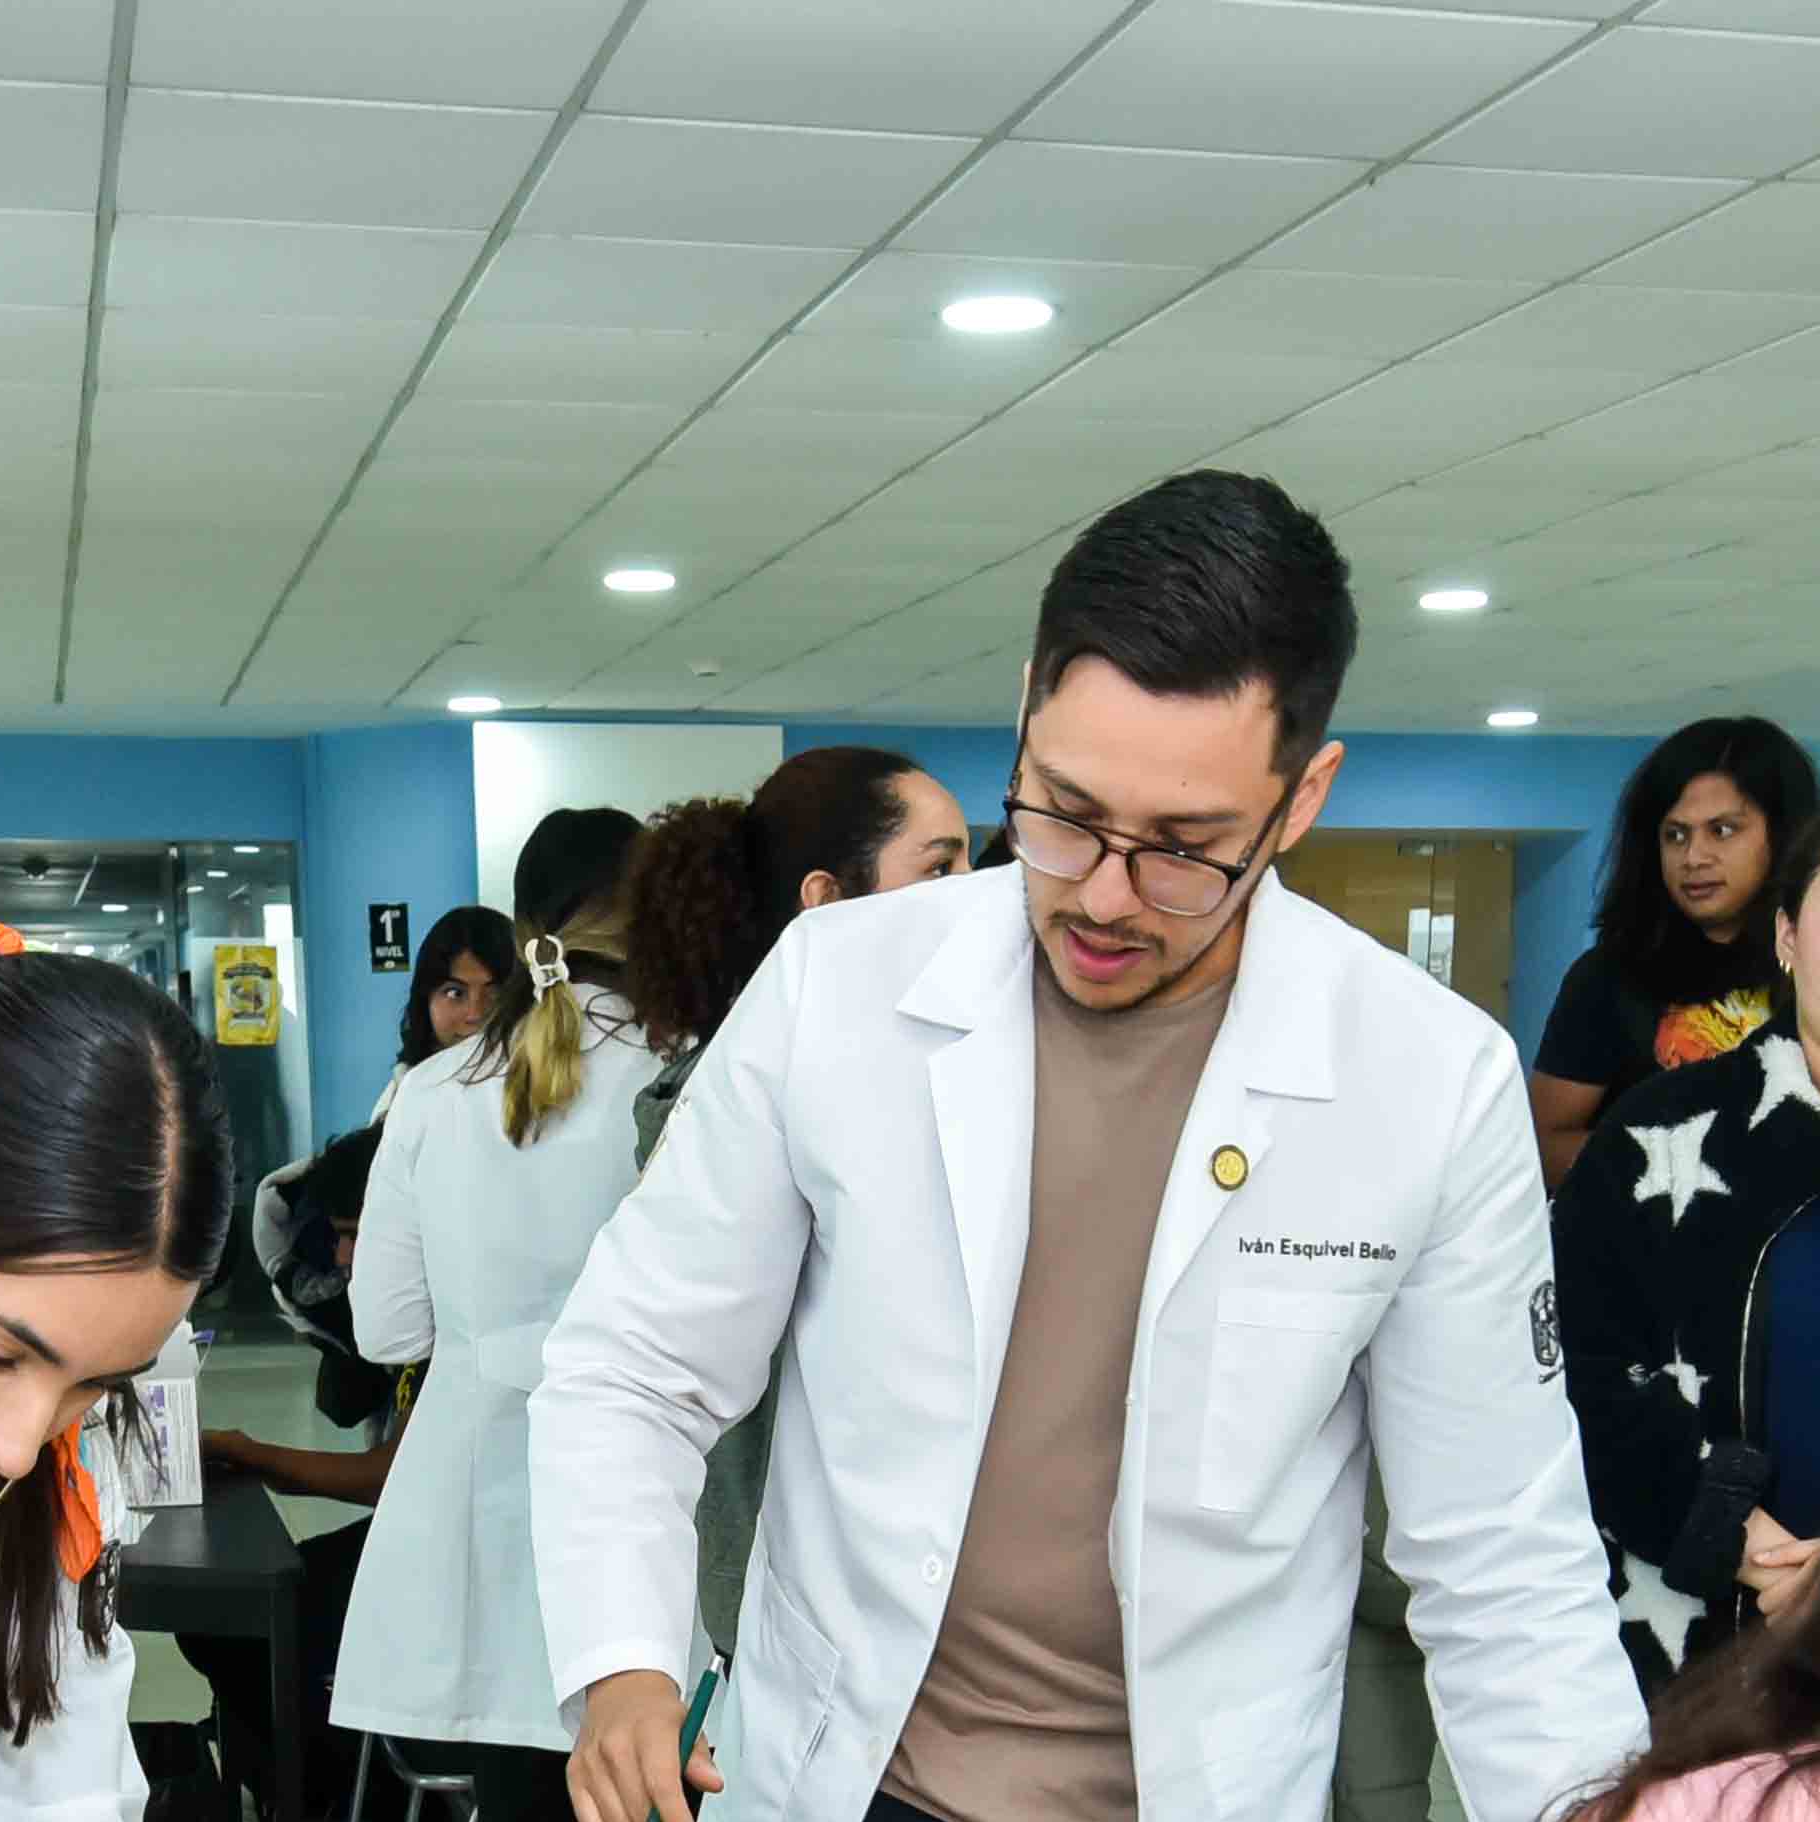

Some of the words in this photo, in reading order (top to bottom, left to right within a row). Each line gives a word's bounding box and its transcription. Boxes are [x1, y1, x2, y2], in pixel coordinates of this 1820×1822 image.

[1238, 1237, 1275, 1255] Iván
[1279, 1238, 1355, 1261] Esquivel
[1359, 1242, 1397, 1262] Bello
